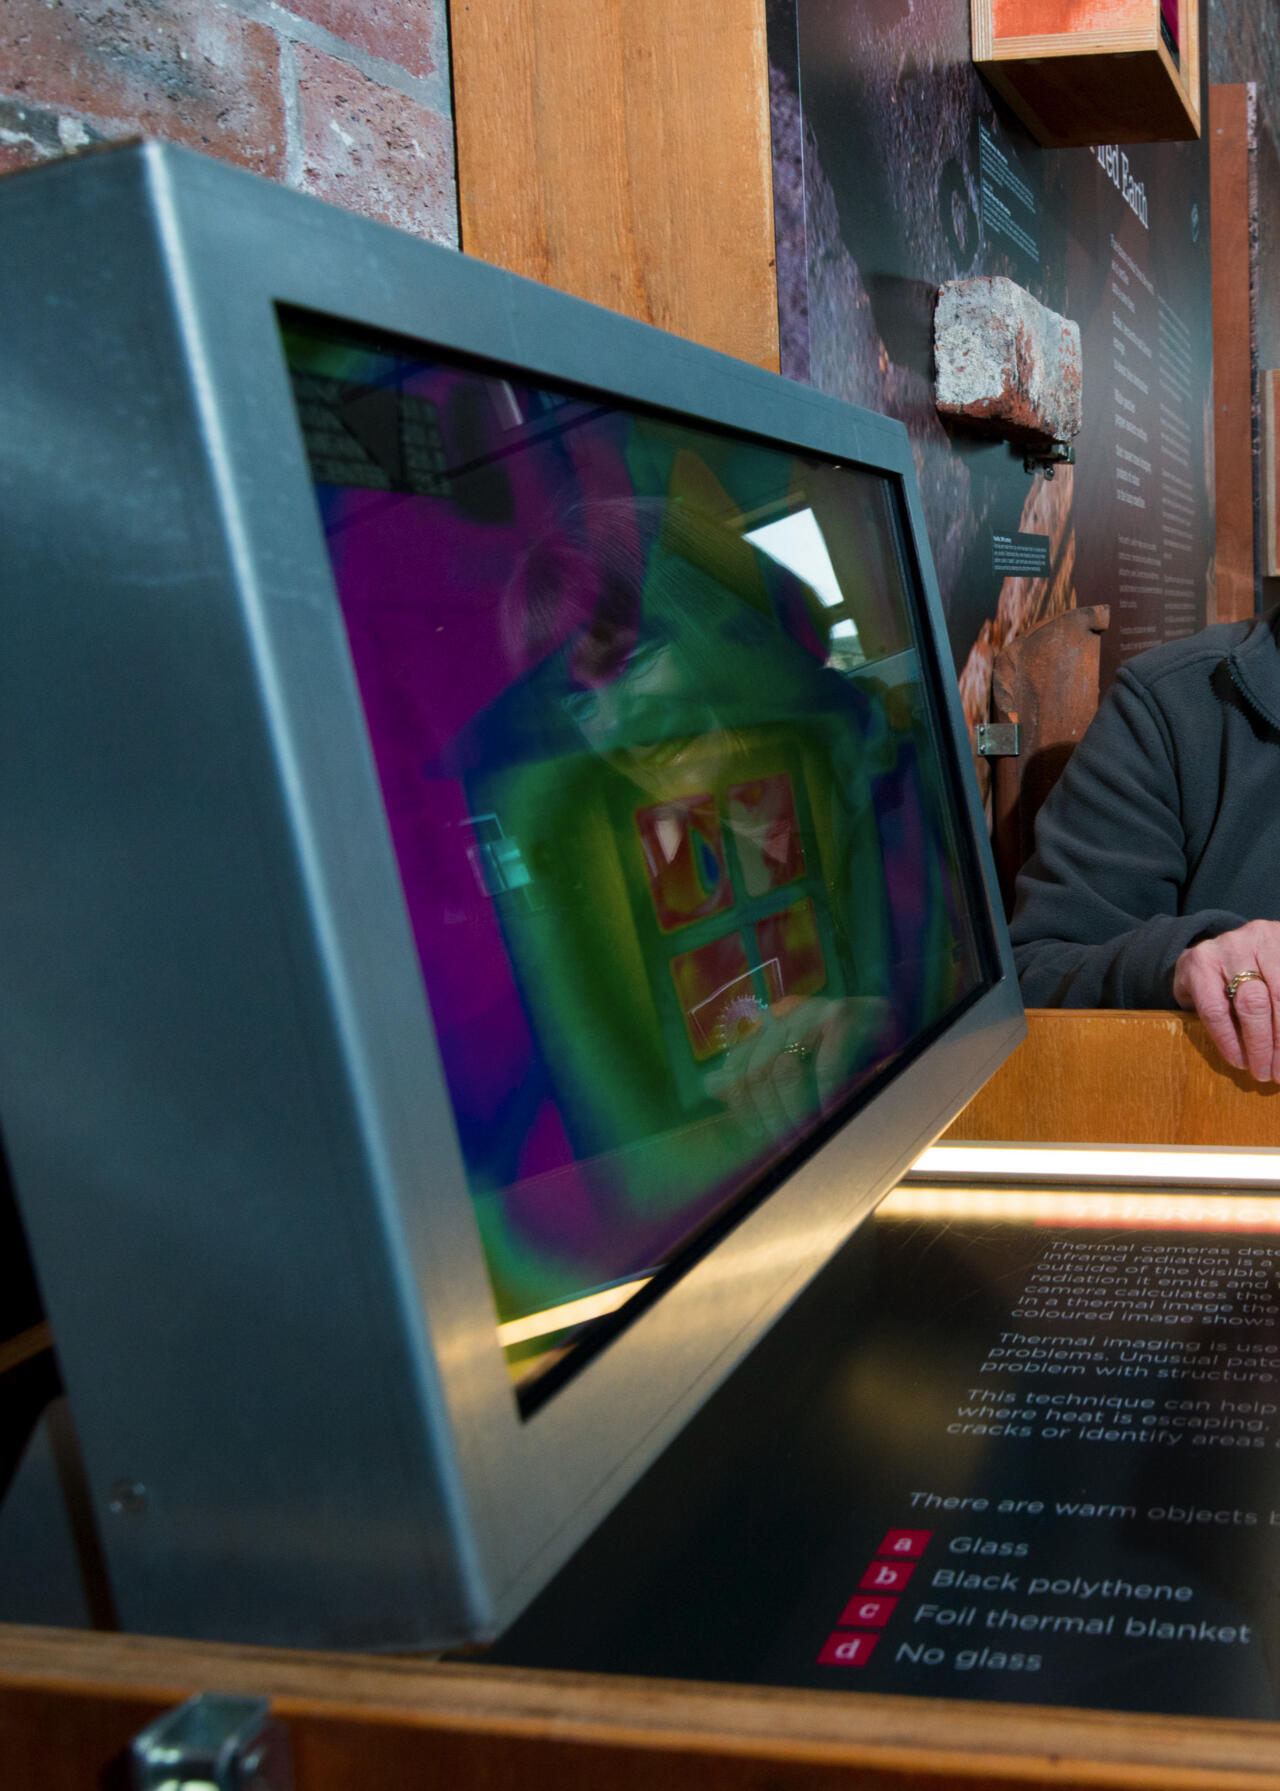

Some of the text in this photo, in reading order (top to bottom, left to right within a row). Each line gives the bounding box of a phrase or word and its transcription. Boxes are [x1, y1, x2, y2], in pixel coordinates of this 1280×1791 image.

[1121, 151, 1149, 230] Earth
[1051, 1241, 1134, 1252] Thermal
[1141, 1245, 1230, 1255] cameras
[1043, 1252, 1127, 1263] Infrared
[1133, 1254, 1229, 1266] radiation
[1237, 1257, 1253, 1266] is
[1260, 1258, 1273, 1267] a
[1037, 1263, 1118, 1273] outside
[1125, 1265, 1147, 1274] of
[1155, 1266, 1190, 1276] the
[1198, 1267, 1267, 1278] visible
[1030, 1273, 1128, 1285] radiation
[1136, 1276, 1151, 1286] it
[1158, 1277, 1219, 1288] emits
[1226, 1279, 1269, 1289] and
[1024, 1285, 1107, 1296] camera
[1115, 1287, 1227, 1300] calculates
[1236, 1290, 1272, 1301] the
[1045, 1298, 1058, 1306] a
[1066, 1297, 1155, 1309] thermal
[1162, 1300, 1234, 1313] image
[1242, 1303, 1279, 1314] the
[1011, 1307, 1114, 1321] coloured
[1121, 1311, 1194, 1325] image
[1201, 1314, 1275, 1326] shows
[999, 1332, 1095, 1347] Thermal
[1103, 1335, 1201, 1351] imaging
[1210, 1340, 1228, 1351] is
[987, 1347, 1109, 1362] problems.
[1119, 1350, 1218, 1366] Unusual
[979, 1360, 1279, 1383] problem with structure.
[967, 1389, 1017, 1403] This
[1026, 1392, 1156, 1411] technique
[1164, 1399, 1211, 1412] can
[1219, 1401, 1278, 1415] help
[957, 1407, 1037, 1421] where
[1045, 1409, 1104, 1423] heat
[1113, 1411, 1132, 1425] is
[946, 1422, 1032, 1438] cracks
[1041, 1428, 1071, 1439] or
[1078, 1428, 1183, 1446] identify
[1192, 1434, 1265, 1449] areas
[909, 1492, 992, 1514] There
[997, 1498, 1044, 1515] are
[1055, 1500, 1137, 1519] warm
[1147, 1503, 1258, 1527] objects
[893, 1536, 1029, 1557] a Glass
[874, 1565, 1194, 1602] b Black polythene
[858, 1602, 1252, 1645] c Foil thermal blanket
[834, 1638, 1043, 1671] d No glass
